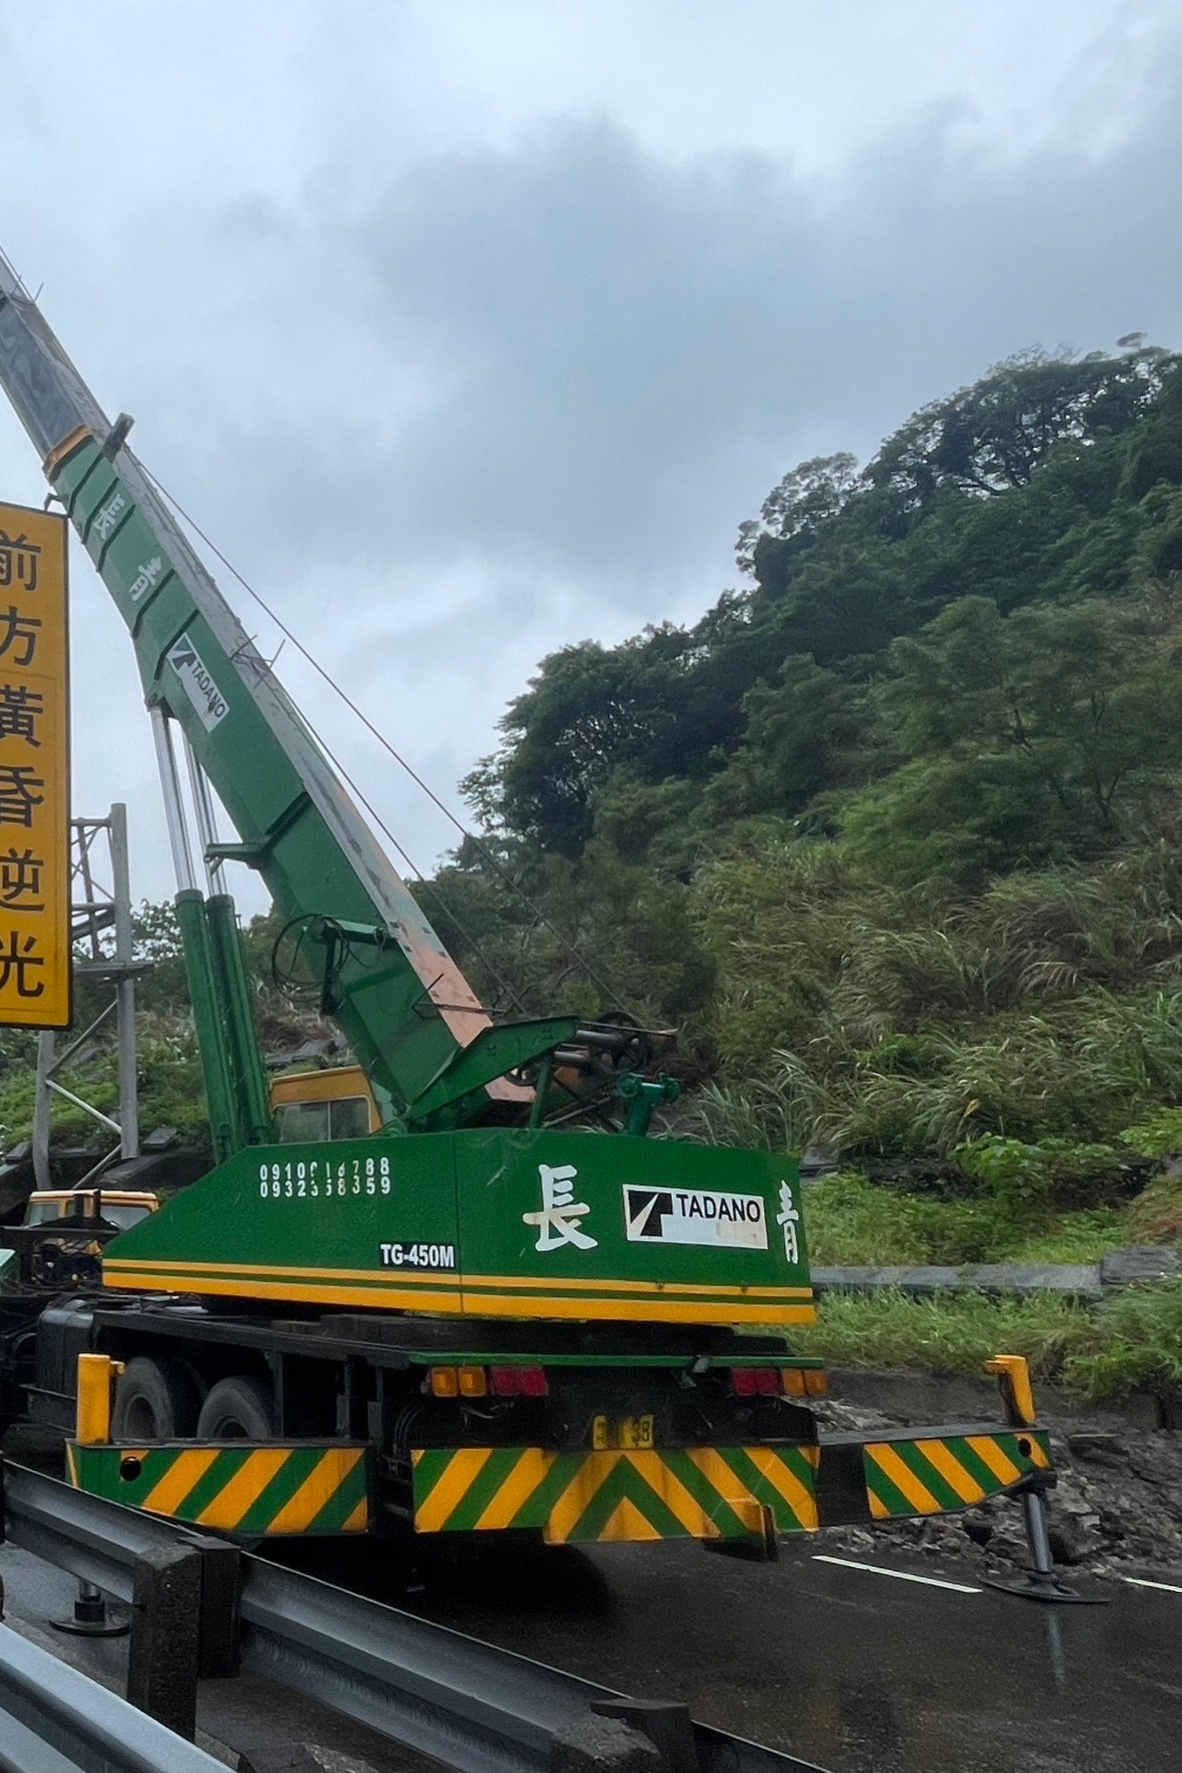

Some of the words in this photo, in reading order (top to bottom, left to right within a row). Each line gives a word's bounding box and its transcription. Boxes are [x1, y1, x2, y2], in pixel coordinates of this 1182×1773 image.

[191, 661, 226, 719] TADANO
[522, 1164, 599, 1252] 長
[675, 1194, 761, 1223] TADANO
[380, 1243, 455, 1268] TG-450M
